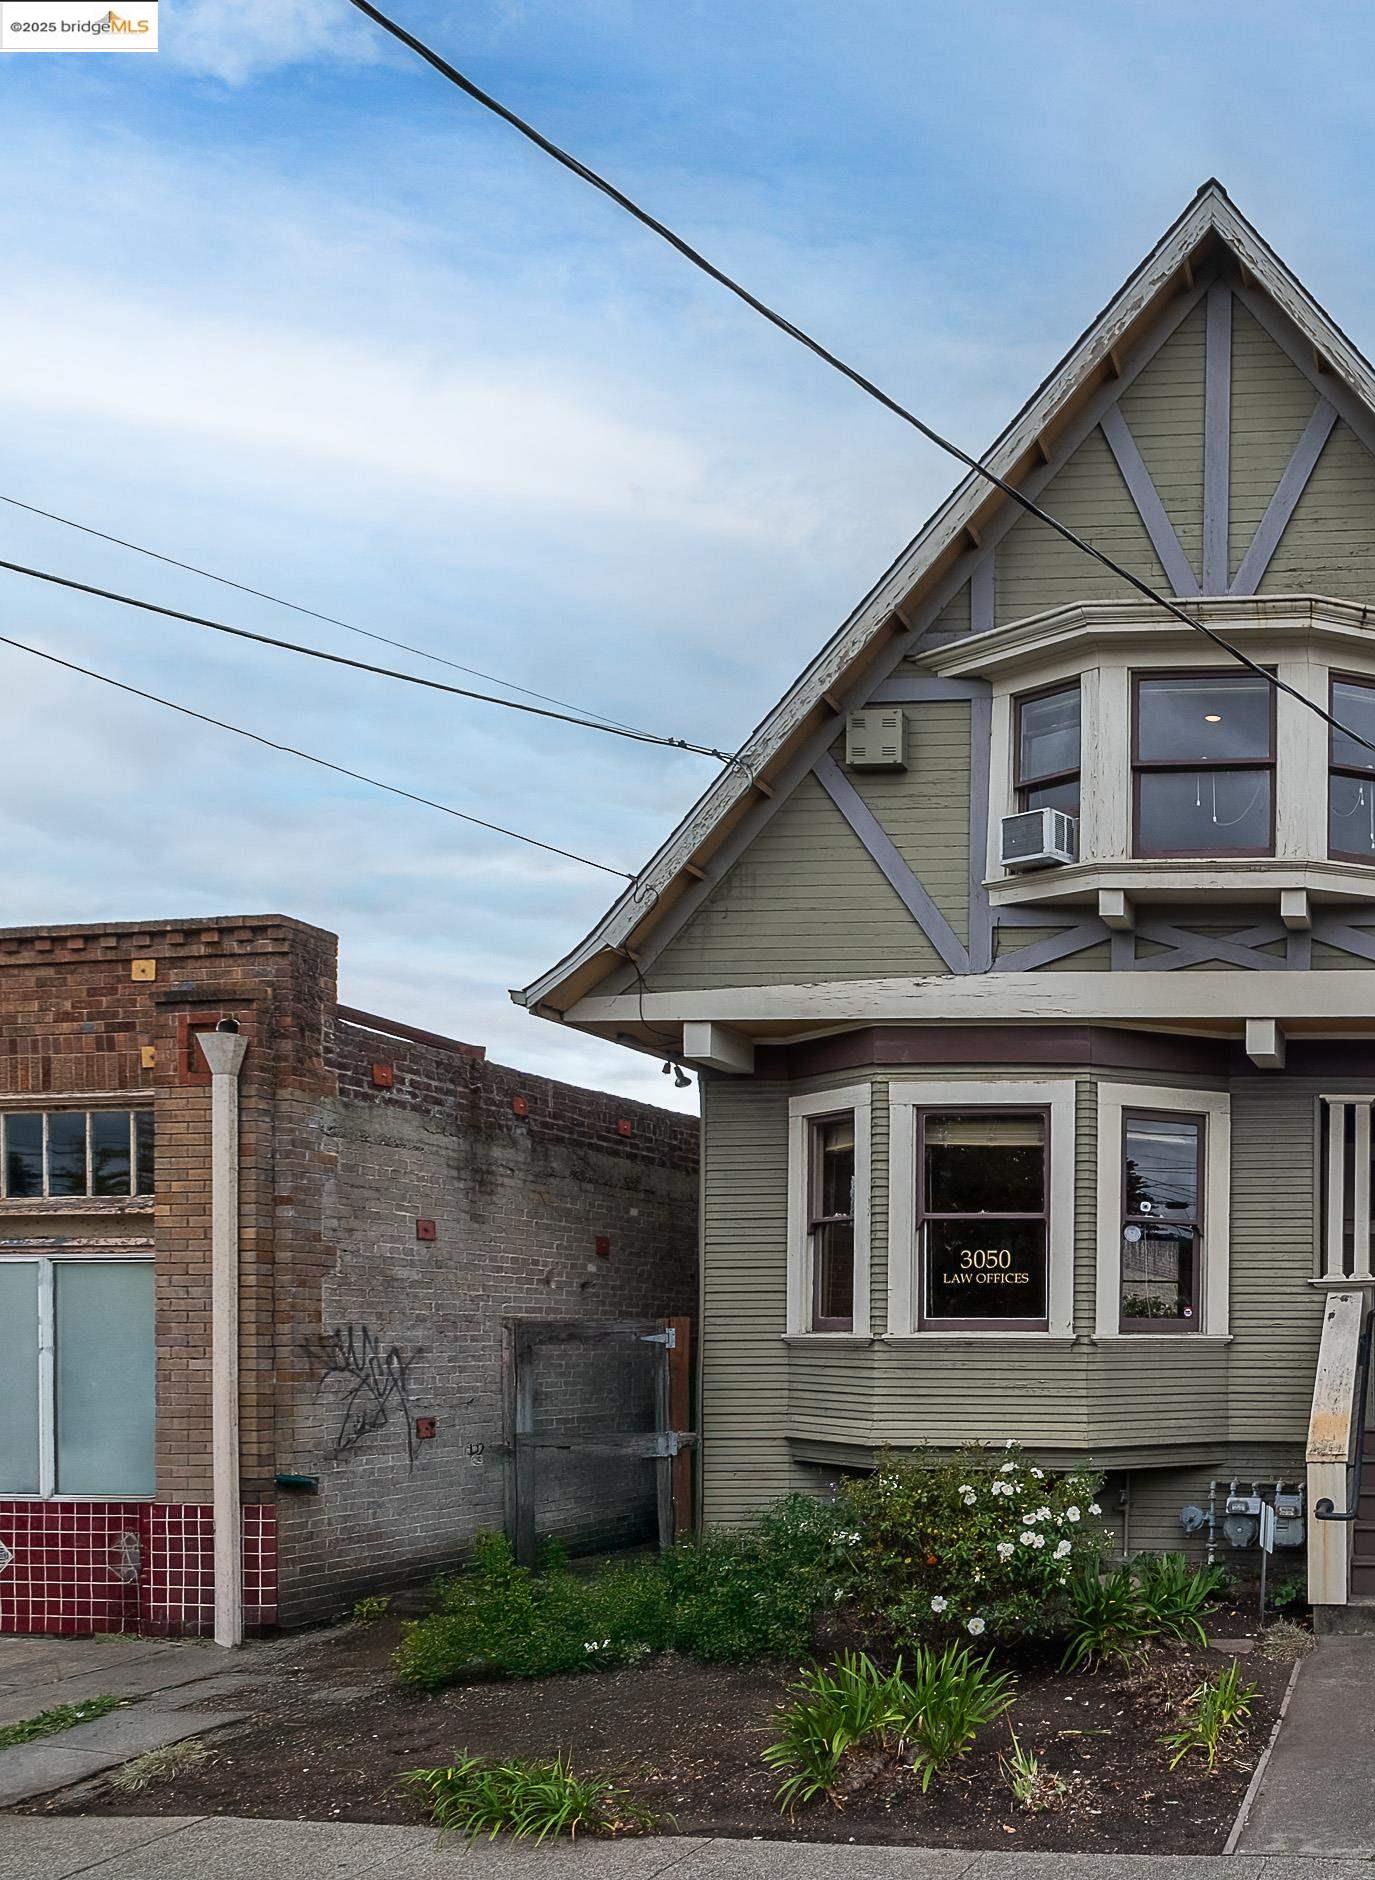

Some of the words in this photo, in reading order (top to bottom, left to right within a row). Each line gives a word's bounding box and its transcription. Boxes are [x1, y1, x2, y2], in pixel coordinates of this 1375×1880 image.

[960, 1249, 1011, 1269] 3050
[943, 1273, 973, 1284] LAW
[976, 1272, 1029, 1284] OFFICES
